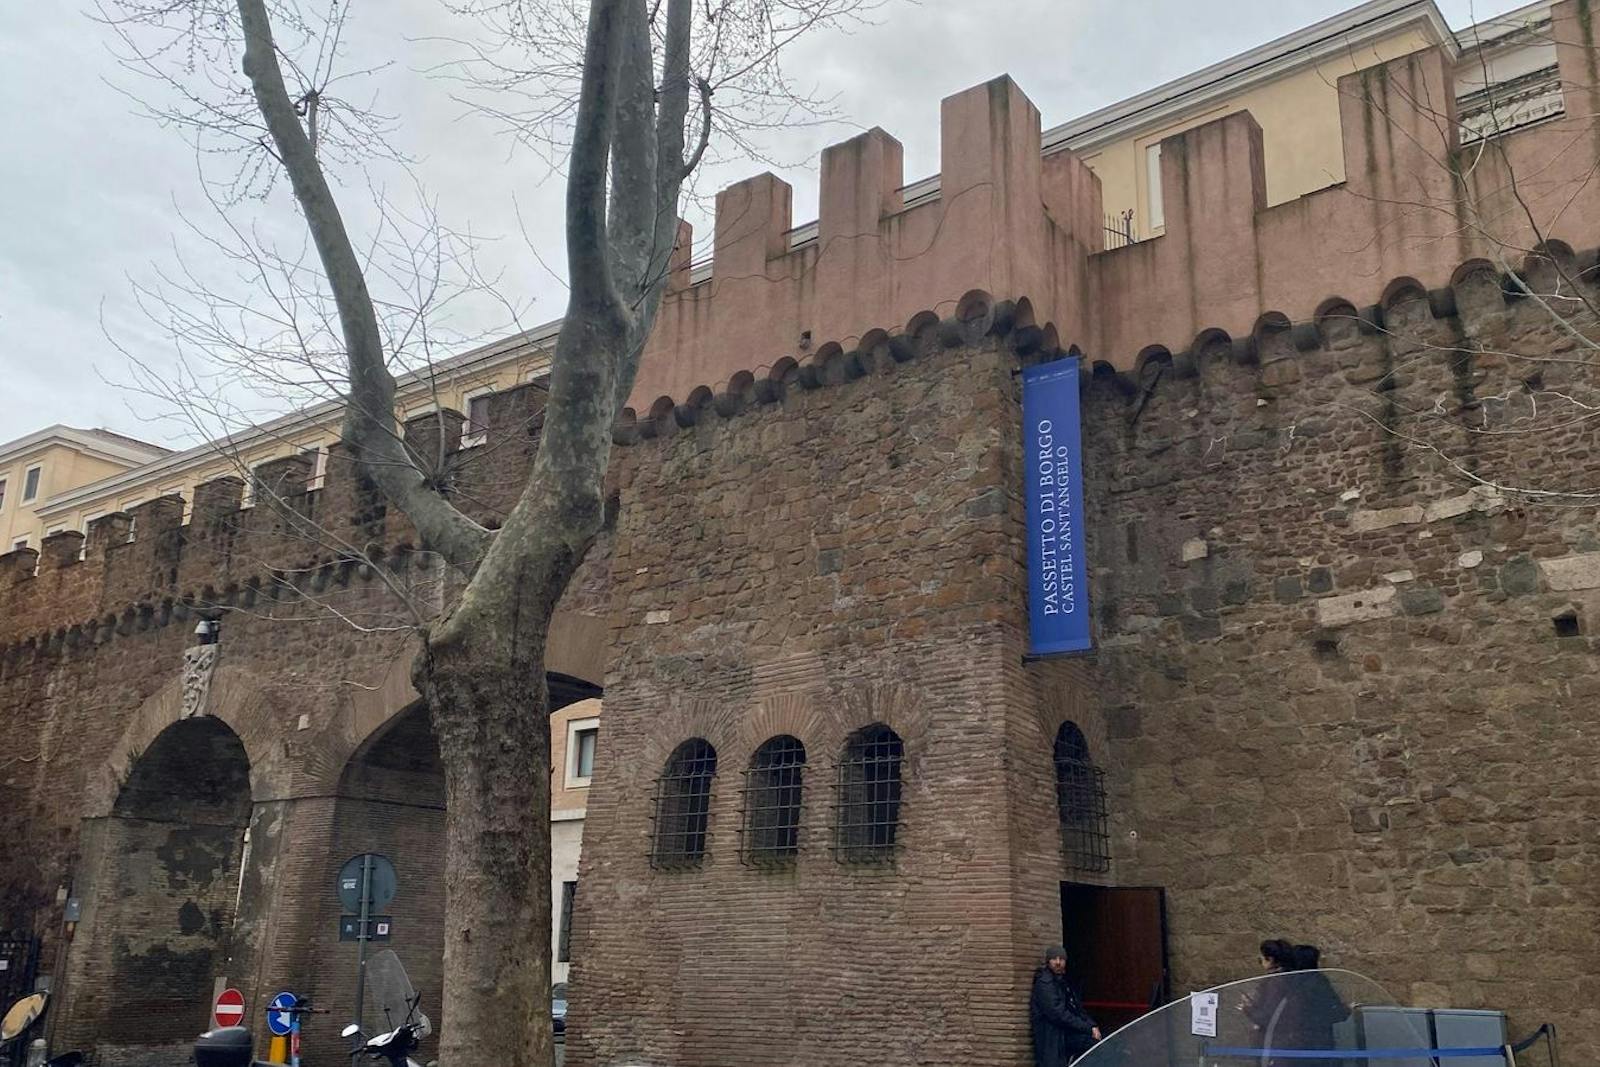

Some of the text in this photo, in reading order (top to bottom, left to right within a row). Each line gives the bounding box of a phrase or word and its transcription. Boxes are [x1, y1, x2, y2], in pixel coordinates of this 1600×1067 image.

[1038, 419, 1059, 615] PASSETTO DI BORGO
[1057, 445, 1074, 614] CASTEL SANT'ANGELO
